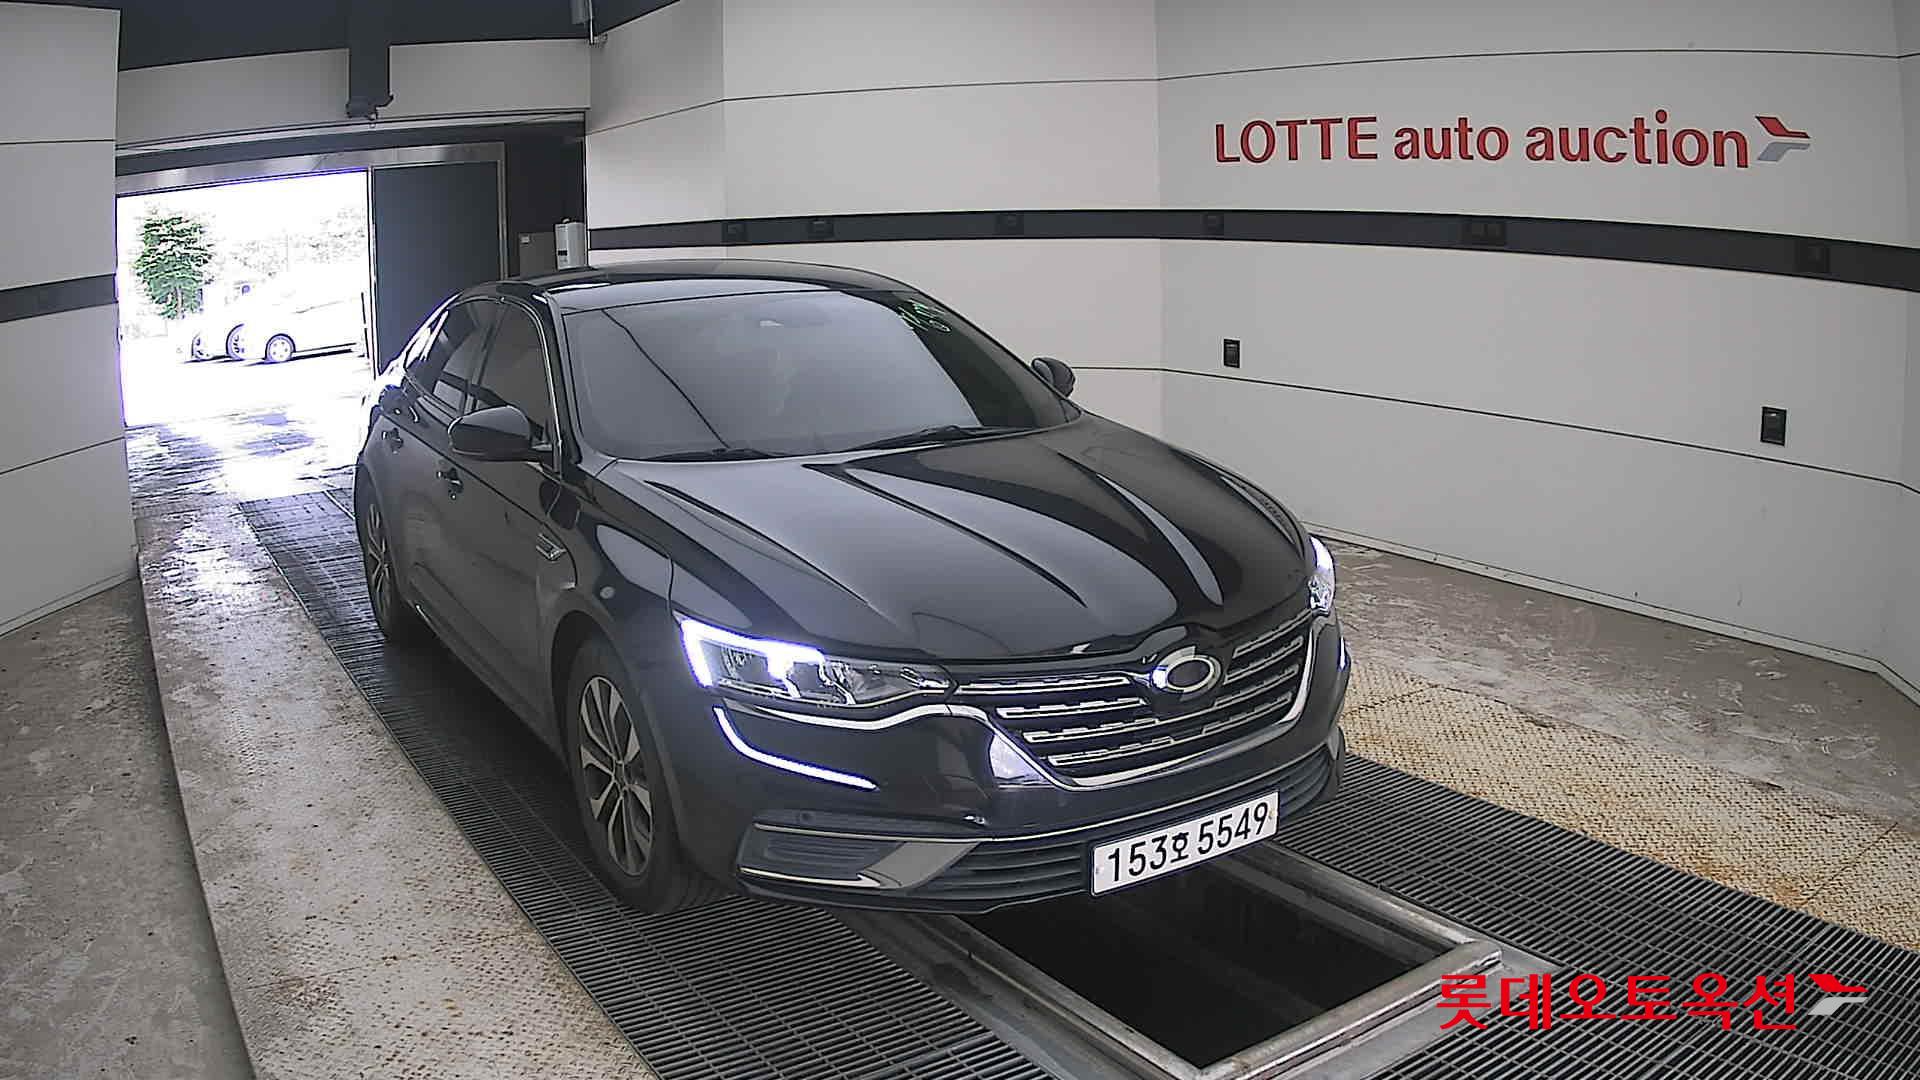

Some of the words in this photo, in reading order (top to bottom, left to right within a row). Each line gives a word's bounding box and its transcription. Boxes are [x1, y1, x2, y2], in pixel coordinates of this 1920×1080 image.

[1216, 116, 1379, 164] LOTTE
[1393, 116, 1511, 162] auto
[1525, 109, 1750, 169] auction
[1197, 802, 1268, 855] 5549
